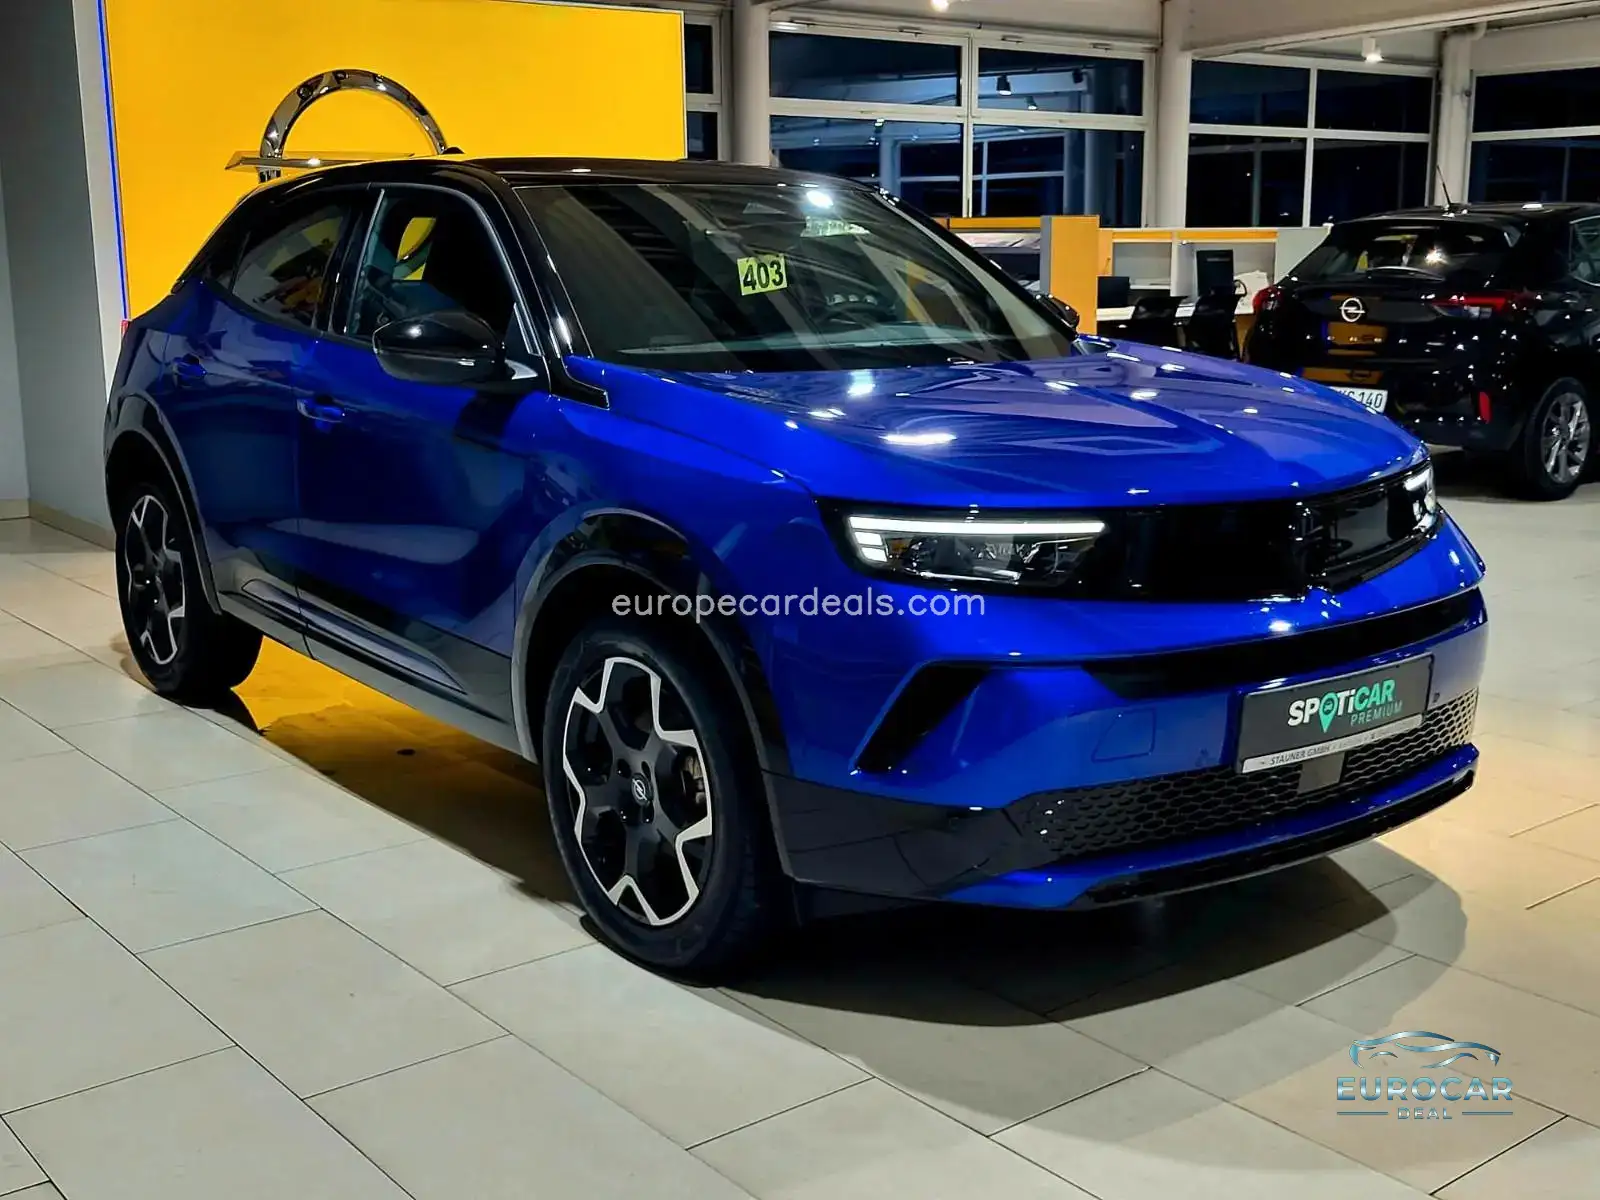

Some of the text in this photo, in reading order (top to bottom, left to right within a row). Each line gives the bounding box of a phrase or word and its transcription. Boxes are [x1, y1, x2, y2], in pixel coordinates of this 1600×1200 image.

[743, 260, 784, 290] 403
[1358, 391, 1383, 409] 140
[1350, 700, 1404, 726] PREMIUM
[1270, 750, 1306, 765] STAUNER
